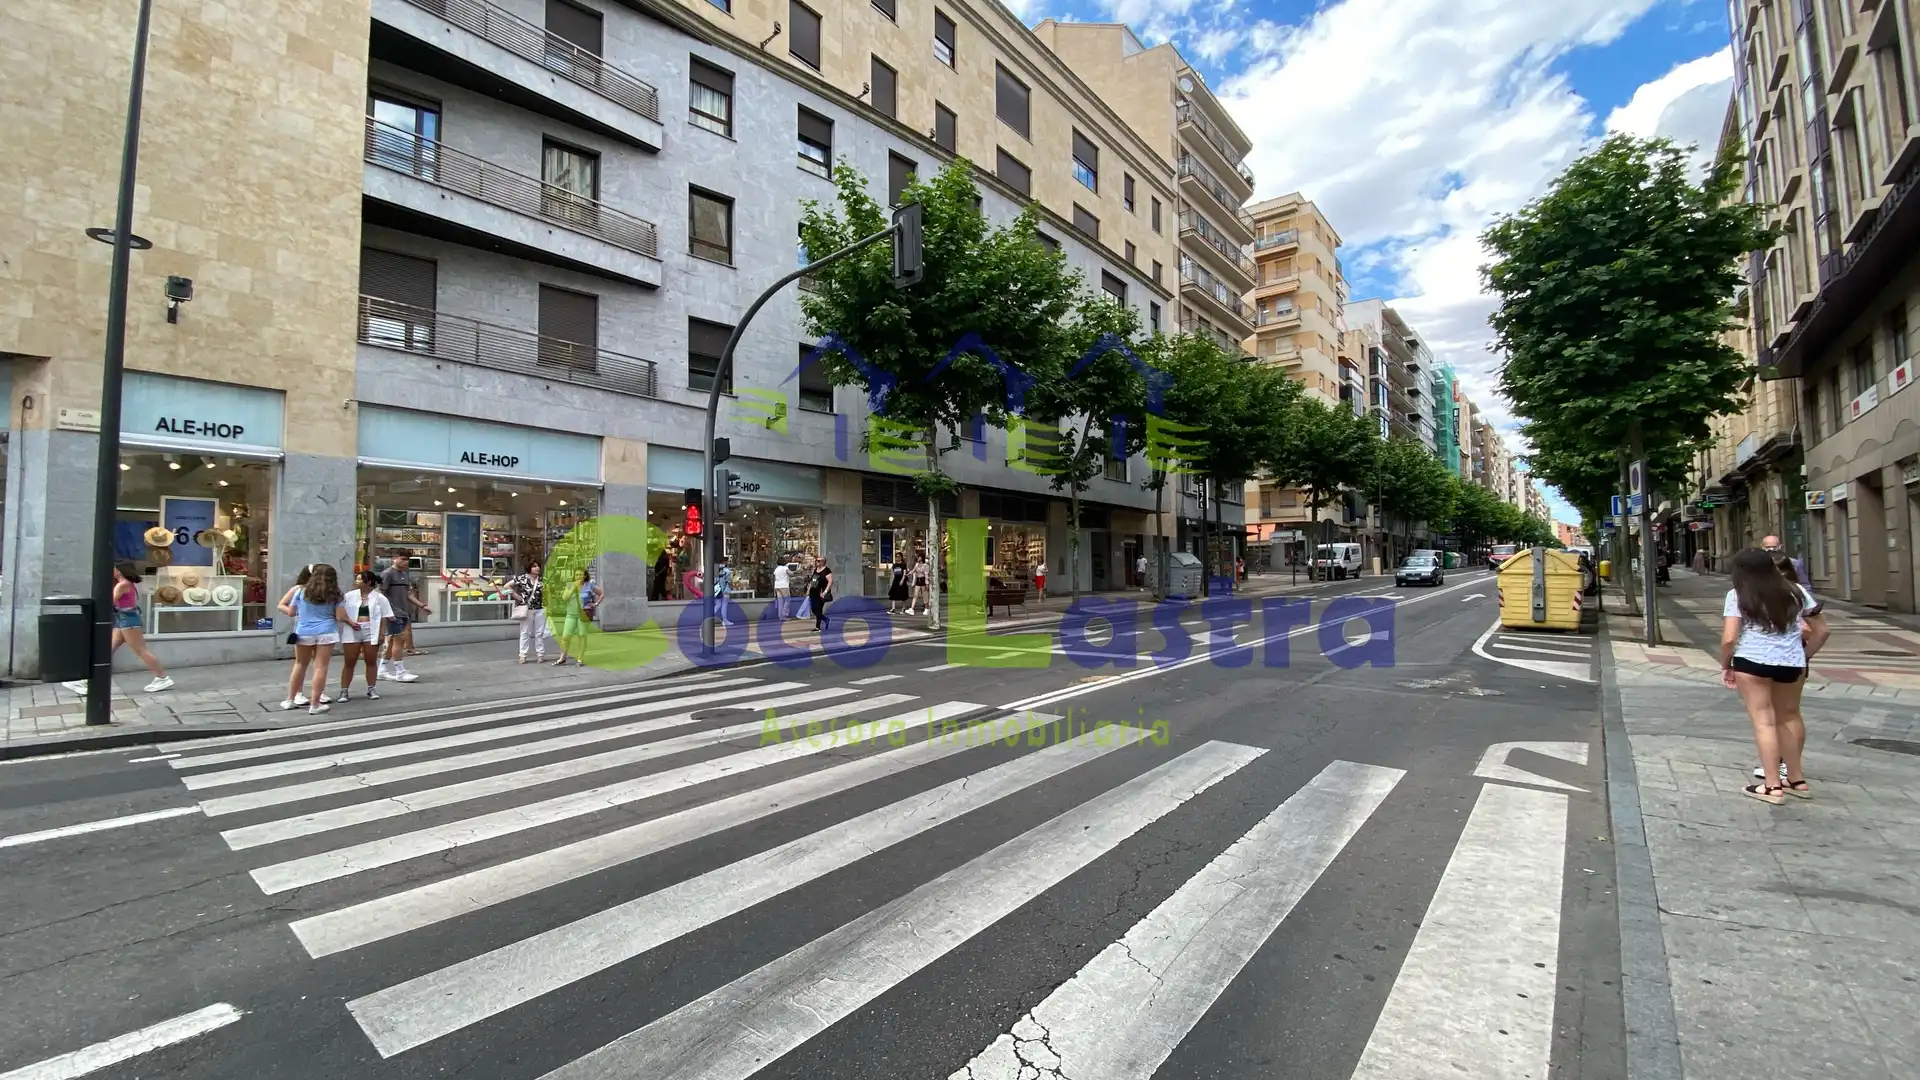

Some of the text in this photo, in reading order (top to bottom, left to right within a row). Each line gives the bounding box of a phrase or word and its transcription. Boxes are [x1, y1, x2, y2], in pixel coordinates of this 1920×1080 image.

[155, 416, 244, 438] ALE-HOP
[460, 451, 519, 468] ALE-HOP
[728, 481, 760, 492] E-HOP
